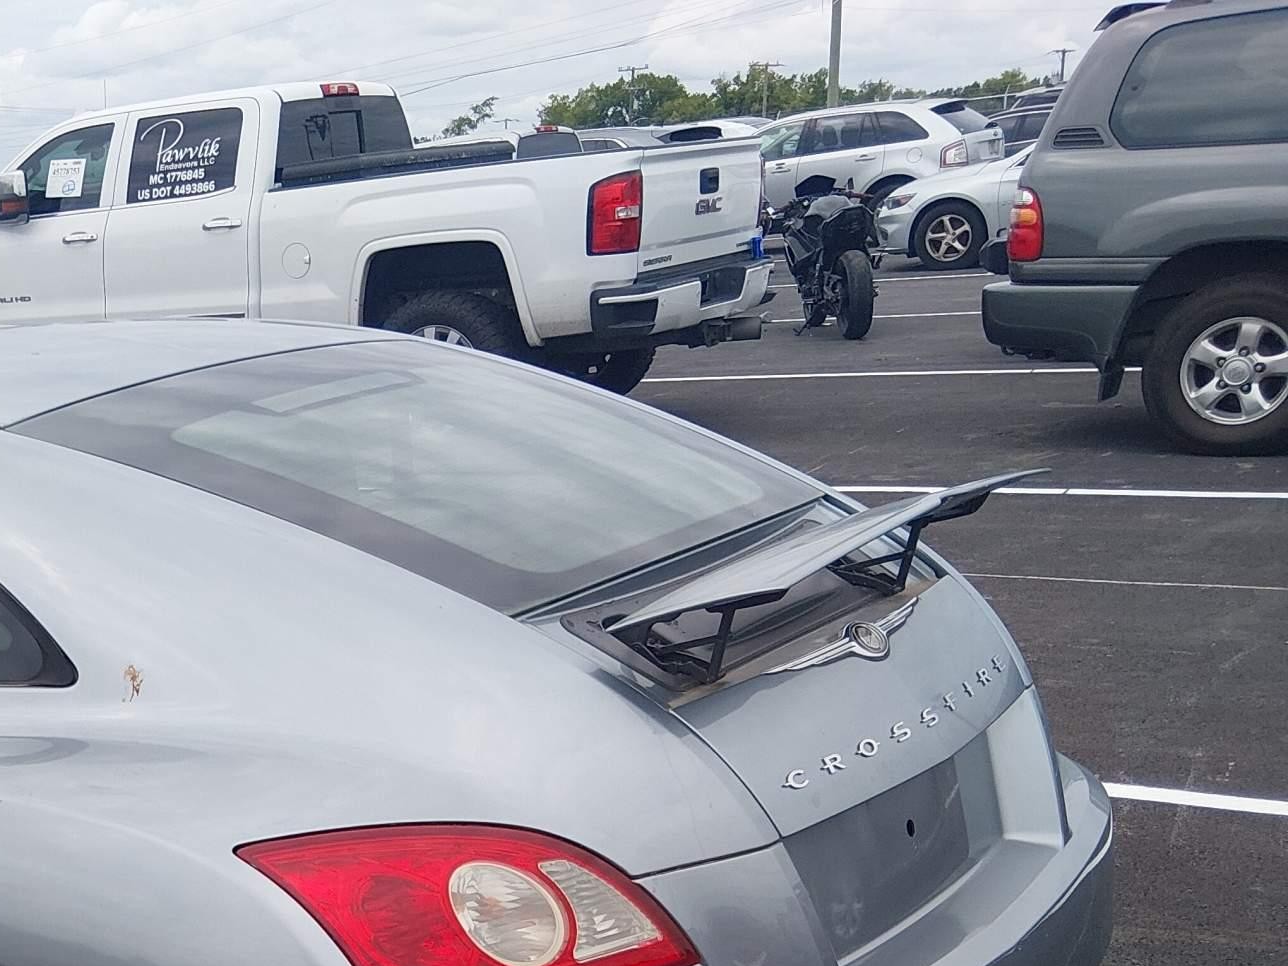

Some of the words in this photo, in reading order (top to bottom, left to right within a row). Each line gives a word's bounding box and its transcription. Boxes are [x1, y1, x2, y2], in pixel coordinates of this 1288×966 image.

[140, 118, 221, 172] Pawvlik
[159, 161, 198, 171] Endeavors
[199, 157, 215, 166] LLC
[149, 173, 164, 185] MC
[166, 168, 205, 183] 1776845
[137, 189, 150, 200] US
[152, 186, 172, 199] DOT
[173, 181, 215, 195] 4493866
[695, 196, 723, 215] GMC
[783, 655, 1007, 789] CROSSFIRE
